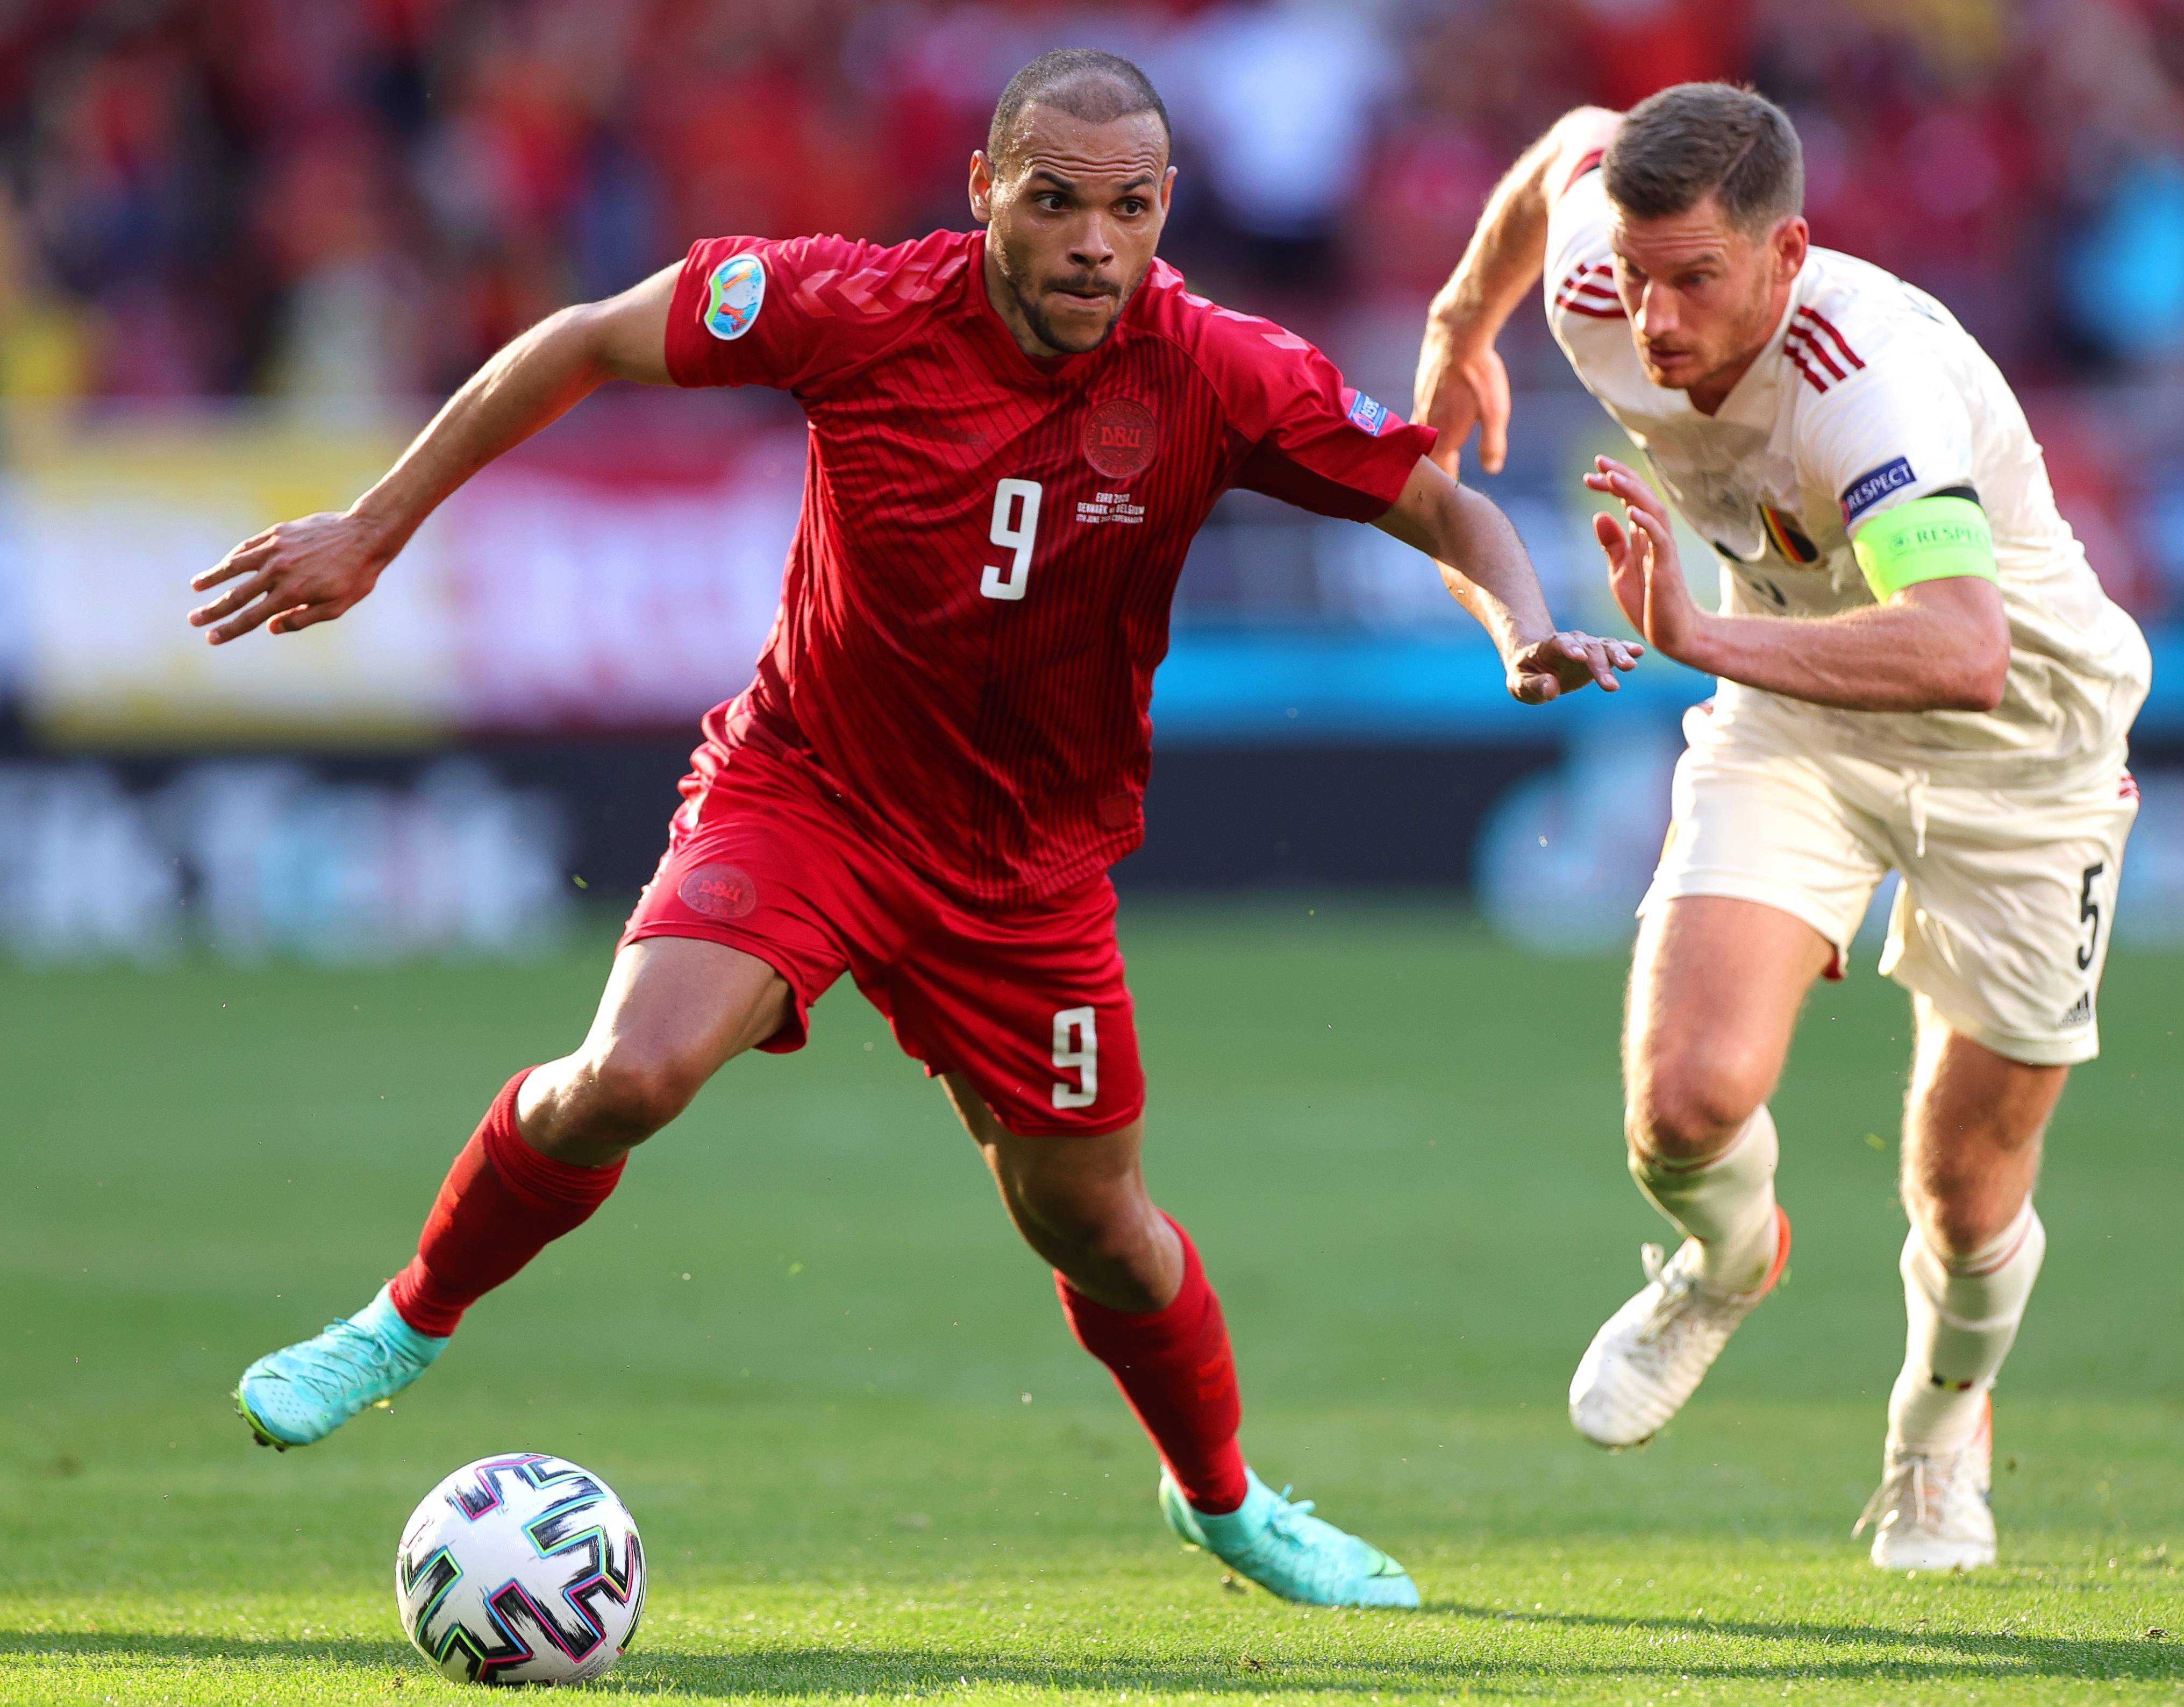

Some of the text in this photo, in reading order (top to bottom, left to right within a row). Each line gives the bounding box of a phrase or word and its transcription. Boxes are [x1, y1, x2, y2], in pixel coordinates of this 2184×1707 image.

[1100, 425, 1141, 448] DBU
[1095, 492, 1113, 503] EURO
[1846, 463, 1910, 510] RESPECT
[1077, 502, 1108, 514] DENMARK
[1116, 503, 1145, 515] BELGIUM
[980, 478, 1043, 600] 9
[1916, 524, 1990, 543] RESPEC
[2077, 862, 2103, 970] 5
[1052, 1006, 1098, 1109] 9
